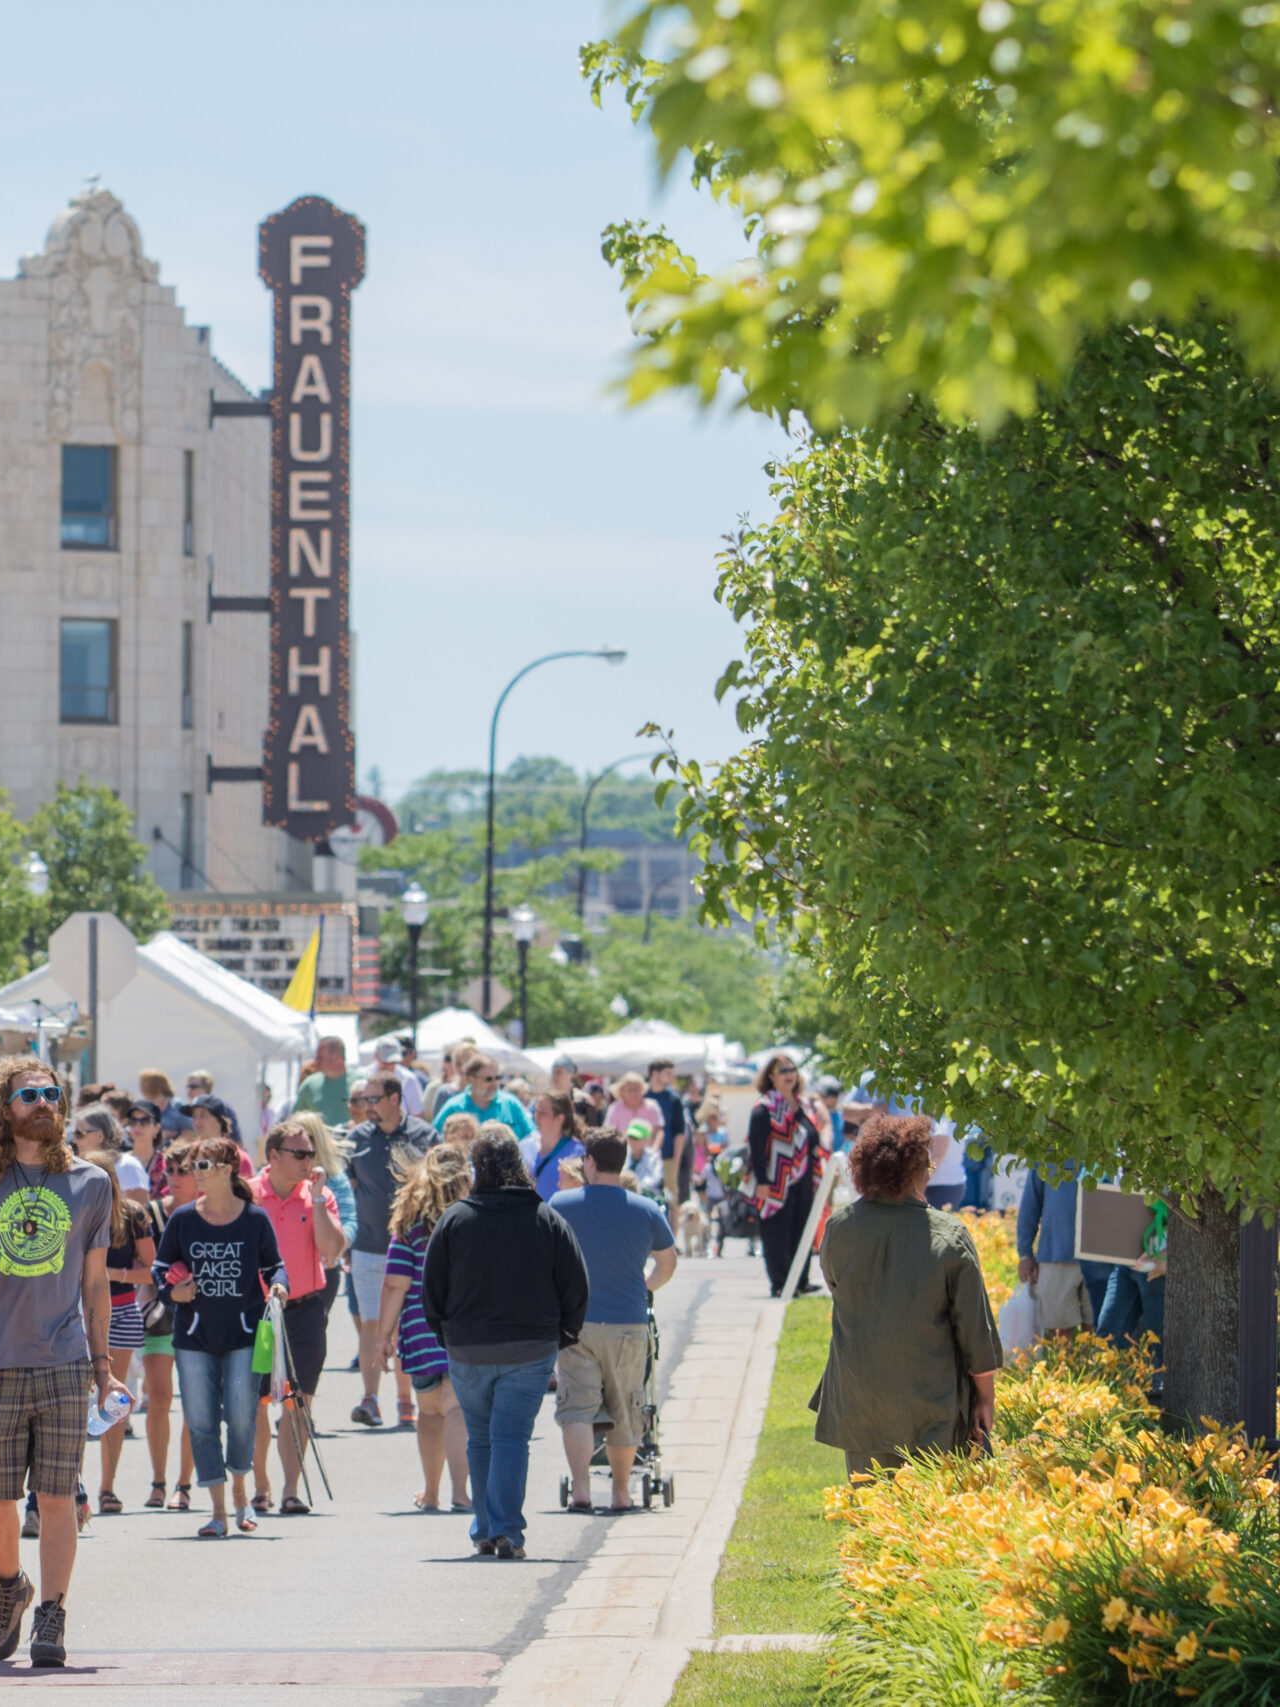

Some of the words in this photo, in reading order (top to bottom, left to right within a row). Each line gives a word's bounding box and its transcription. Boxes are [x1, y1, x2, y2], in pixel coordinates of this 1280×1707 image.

[288, 234, 333, 812] FRAUENTHAL
[189, 1241, 244, 1259] GREAT
[191, 1260, 242, 1278] LAKES
[201, 1279, 243, 1297] GIRL
